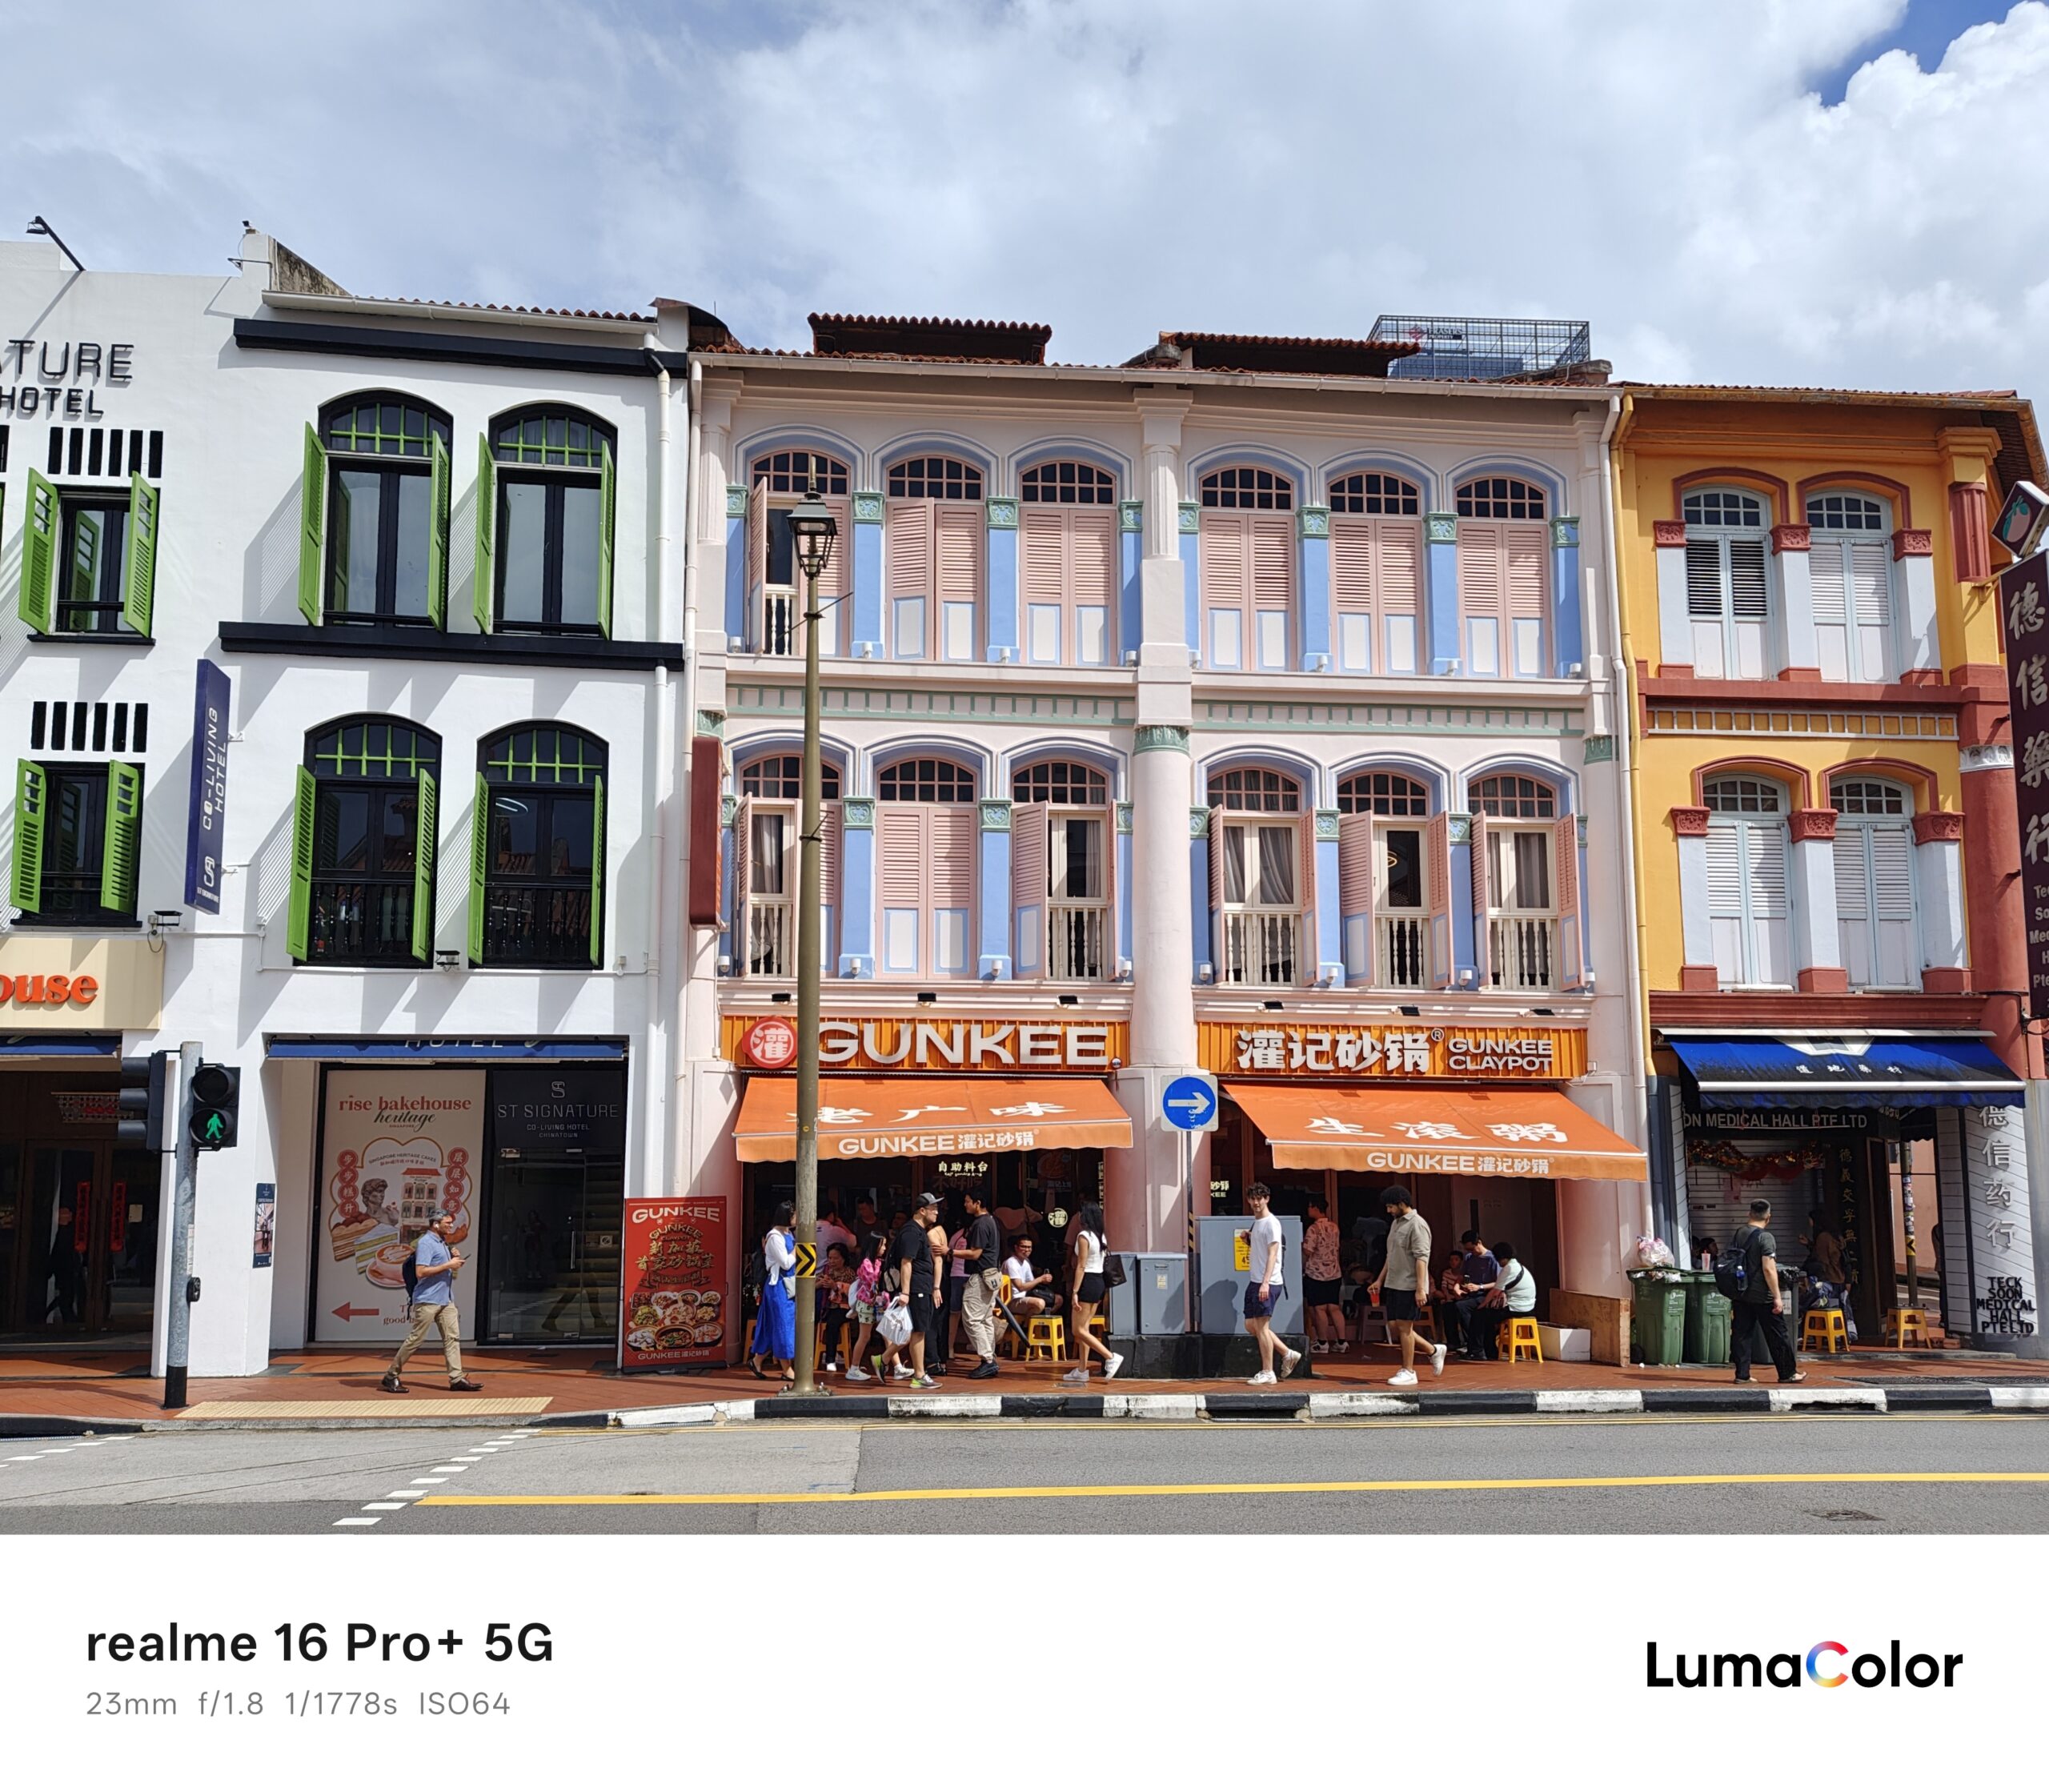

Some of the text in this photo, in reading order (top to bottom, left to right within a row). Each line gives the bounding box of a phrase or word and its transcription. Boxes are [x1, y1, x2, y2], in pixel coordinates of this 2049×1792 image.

[0, 339, 134, 379] TURE
[0, 386, 104, 414] HOTEL
[202, 707, 218, 831] CO-LIVING
[214, 743, 227, 813] HOTEL
[753, 1028, 792, 1060] 灌
[818, 1021, 1109, 1065] GUNKEE
[1449, 1038, 1554, 1054] GUNKEE
[1449, 1055, 1552, 1071] CLAYPOT
[339, 1095, 471, 1111] rise bakehouse
[498, 1104, 619, 1118] ST SIGNATURE
[373, 1110, 436, 1133] heritage
[1706, 1114, 1769, 1128] MEDICAL
[1772, 1114, 1809, 1127] HALL
[1306, 1117, 1569, 1143] 生滚粥
[838, 1131, 1035, 1155] GUNKEE 灌记砂锅
[938, 1161, 988, 1173] 自助料台
[1367, 1152, 1550, 1175] GUNKEE 灌记砂锅
[1979, 1106, 2016, 1248] 德信药行
[632, 1206, 720, 1224] GUNKEE
[649, 1225, 703, 1240] GUNKEE
[1987, 1277, 2023, 1289] TECK
[1988, 1288, 2023, 1299] SOON
[1976, 1298, 2036, 1311] MEDICAL
[383, 1316, 406, 1325] good
[1990, 1309, 2025, 1323] HALL
[638, 1352, 680, 1360] GUNKEE
